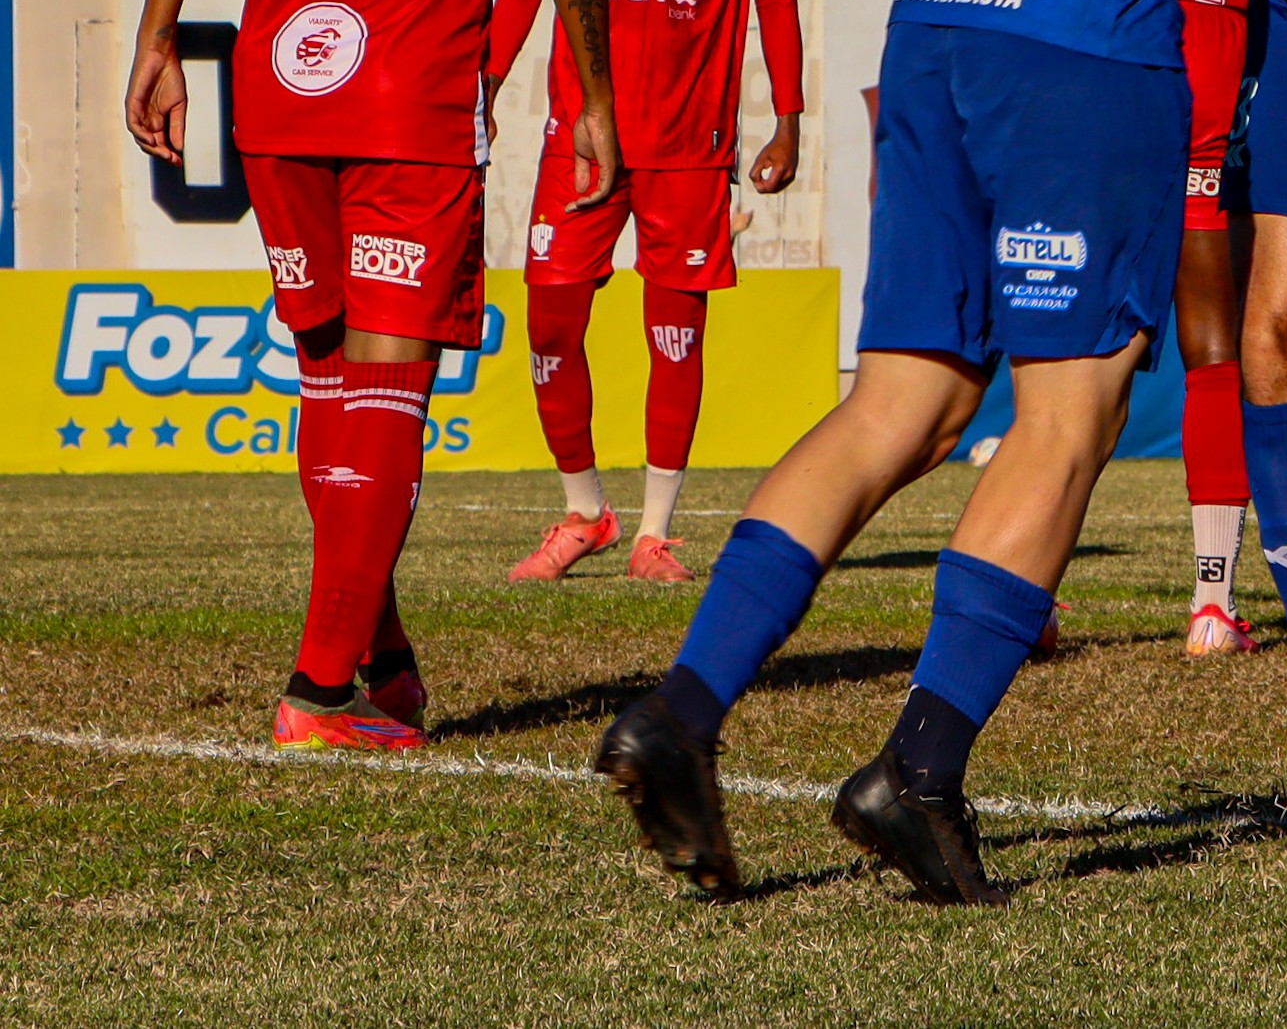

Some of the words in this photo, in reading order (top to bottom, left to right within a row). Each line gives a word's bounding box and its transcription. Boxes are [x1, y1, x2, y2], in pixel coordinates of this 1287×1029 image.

[267, 245, 307, 261] NSTER
[351, 233, 427, 258] MONSTER
[350, 247, 426, 280] BODY
[59, 287, 500, 388] FozS
[205, 405, 472, 455] Calos
[1198, 559, 1222, 581] FS
